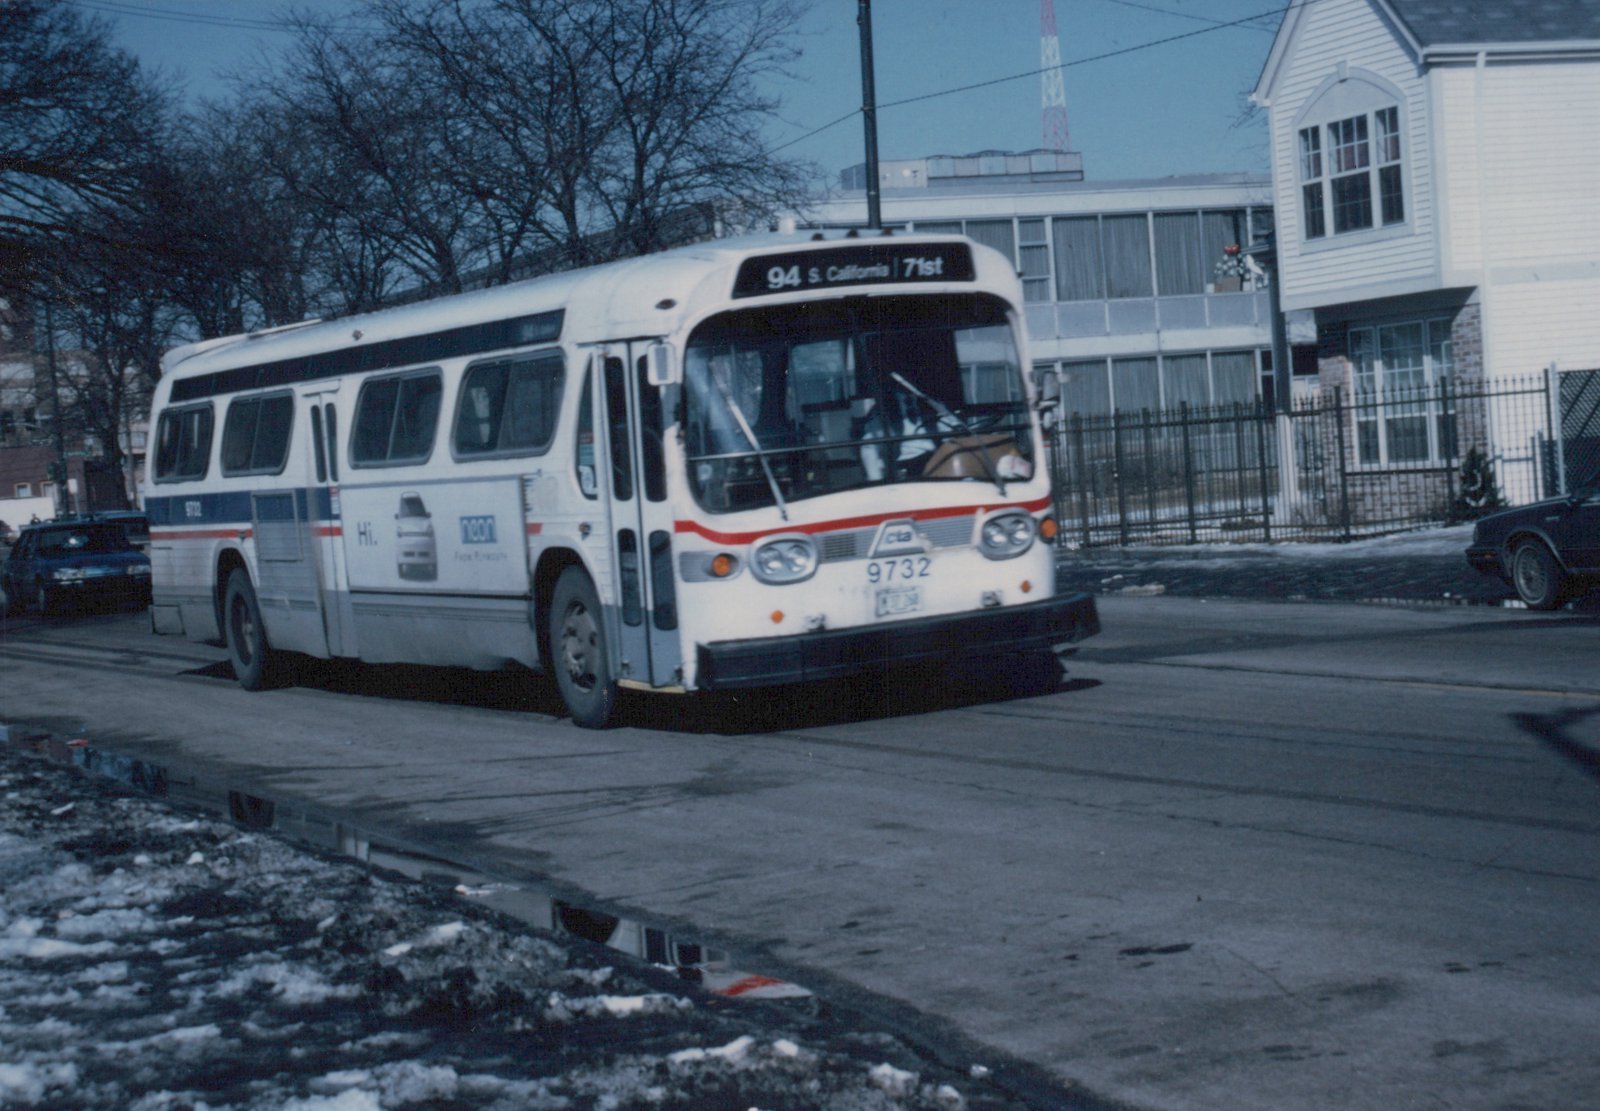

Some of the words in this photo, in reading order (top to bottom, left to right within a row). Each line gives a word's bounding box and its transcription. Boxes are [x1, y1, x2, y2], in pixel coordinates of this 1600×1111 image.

[767, 264, 802, 290] 94
[808, 266, 823, 284] S.
[826, 262, 890, 282] California
[903, 256, 943, 278] 71st
[357, 521, 378, 547] Hi.
[867, 557, 932, 584] 9732
